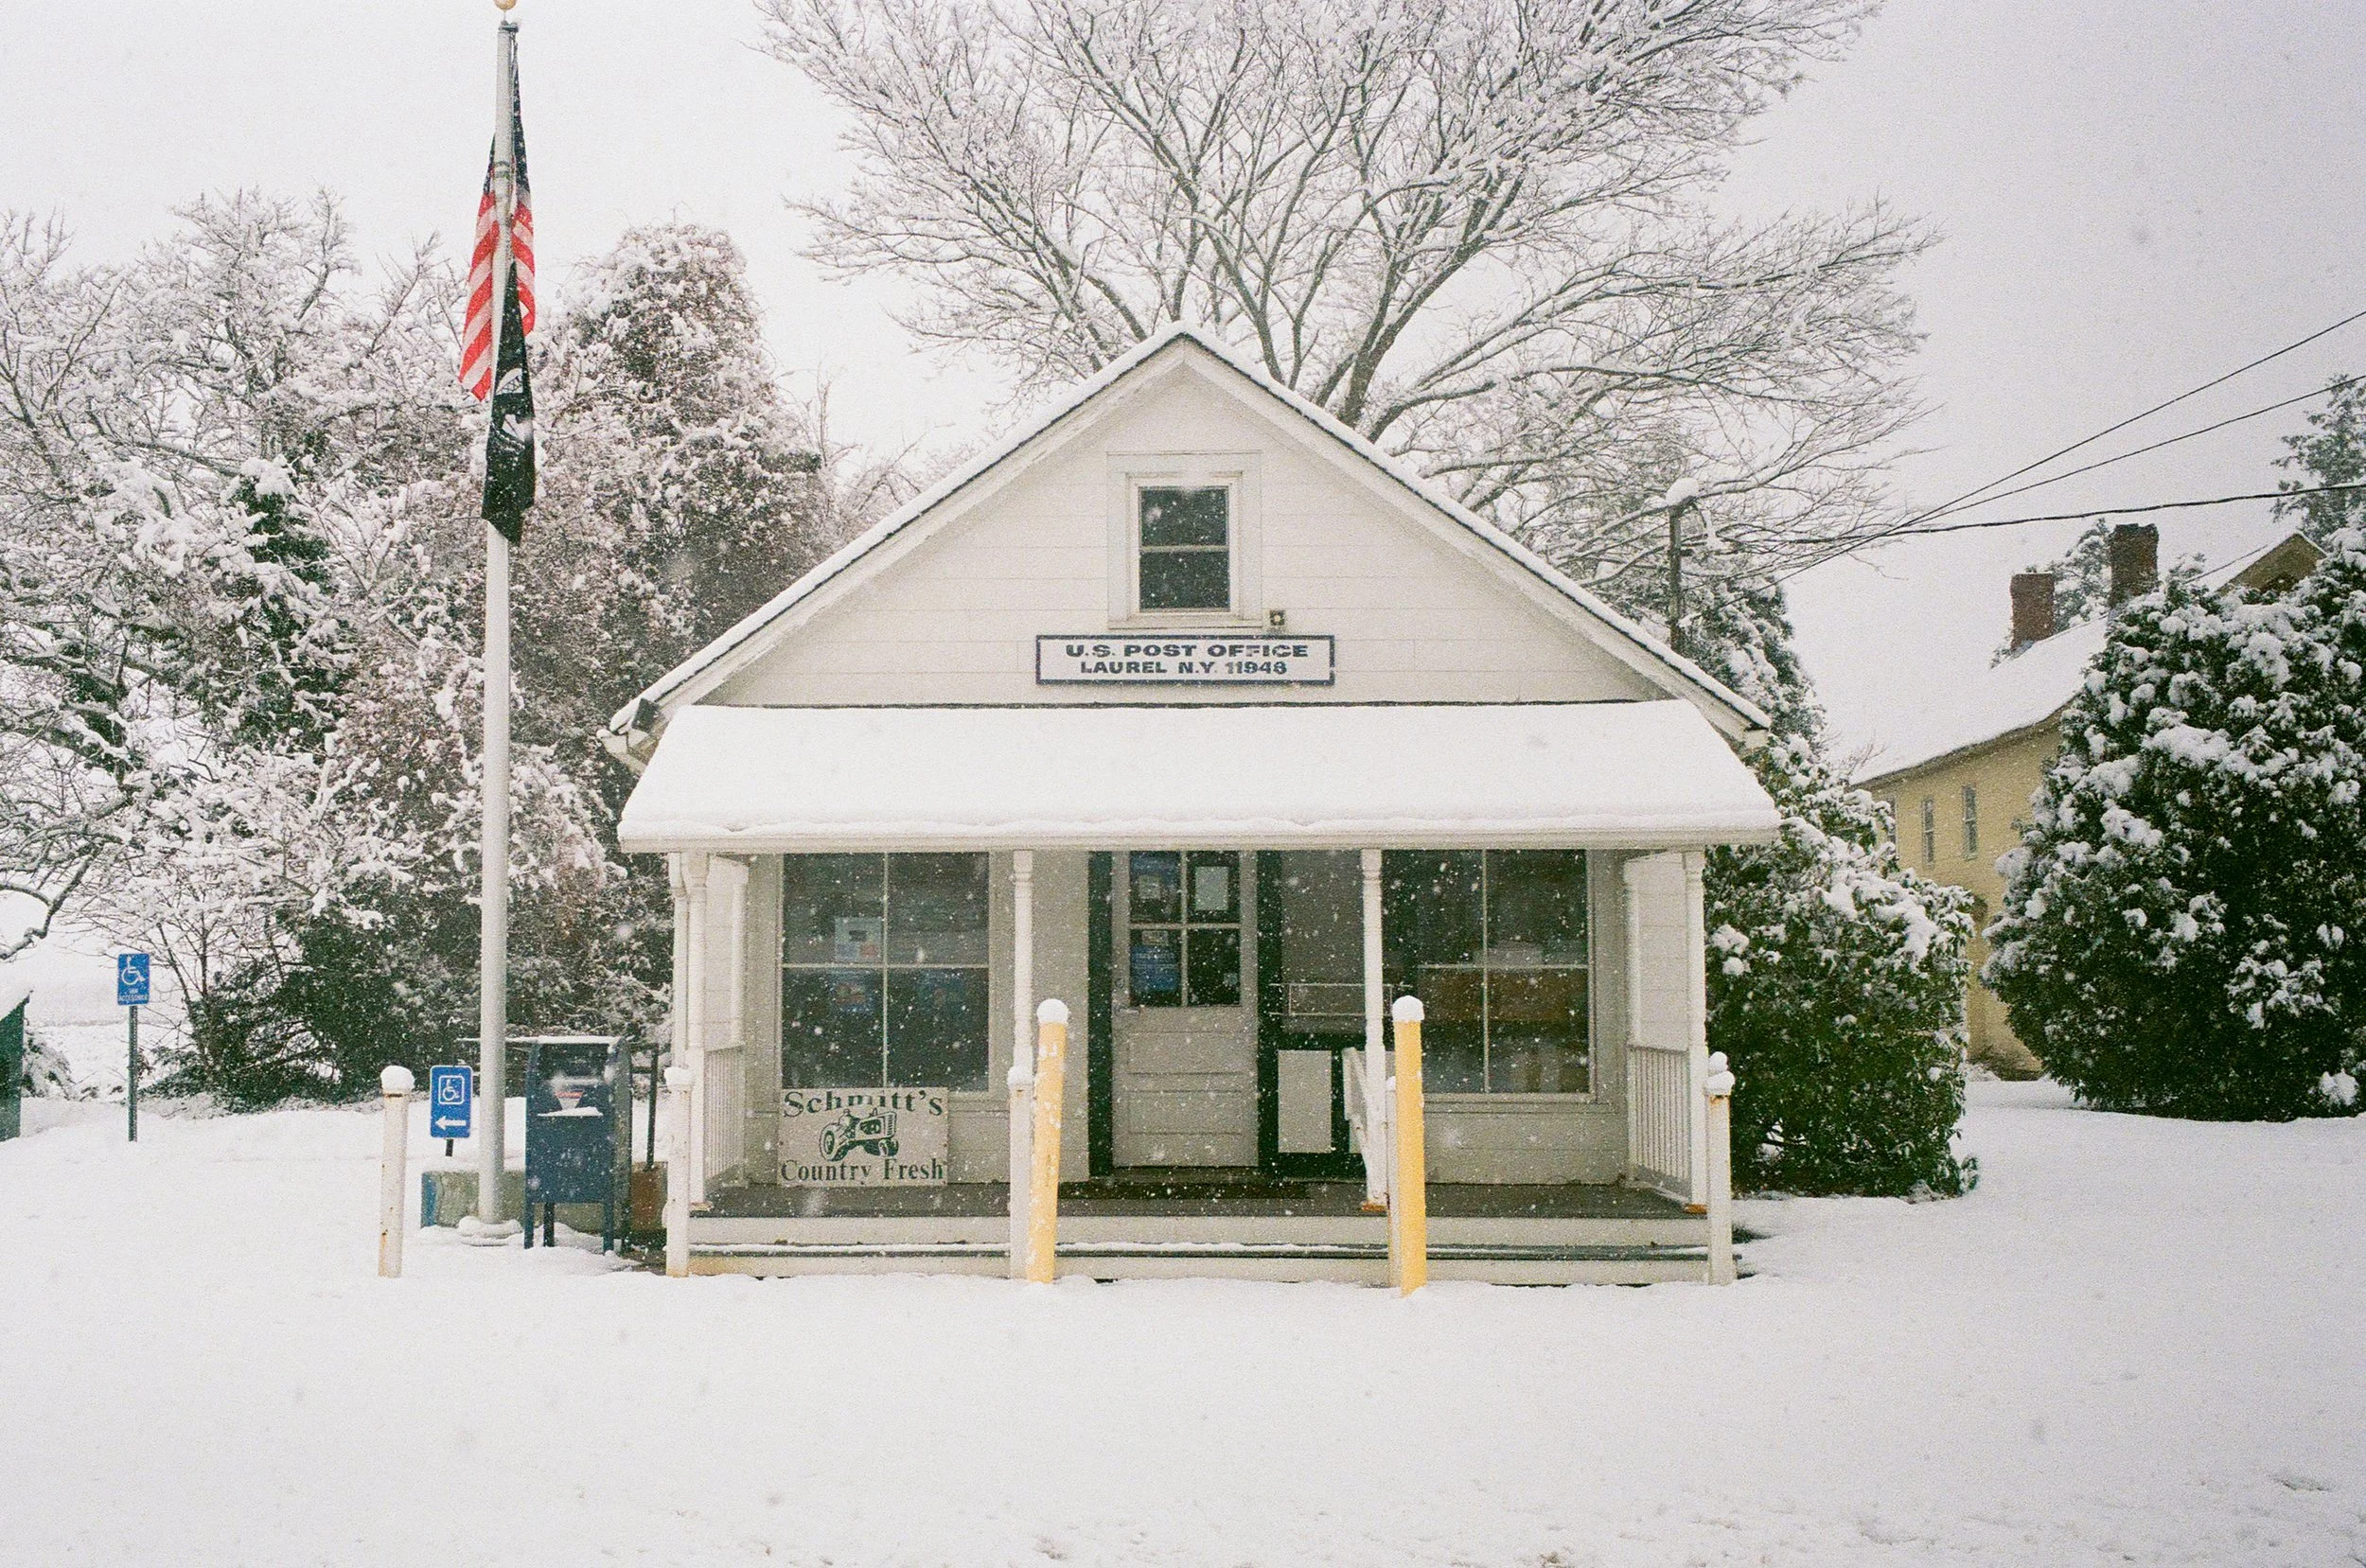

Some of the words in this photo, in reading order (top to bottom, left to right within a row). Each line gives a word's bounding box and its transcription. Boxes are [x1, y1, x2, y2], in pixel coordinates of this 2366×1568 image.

[1066, 644, 1117, 658] U.S.
[1123, 644, 1198, 658] POST
[1207, 644, 1309, 658] OFFICE
[1080, 661, 1168, 675] LAUREL
[1178, 661, 1218, 675] N.Y.
[1225, 661, 1288, 675] 11948
[783, 1089, 944, 1118] Schmitt's
[780, 1159, 872, 1183] Country
[883, 1157, 944, 1181] Fresh
